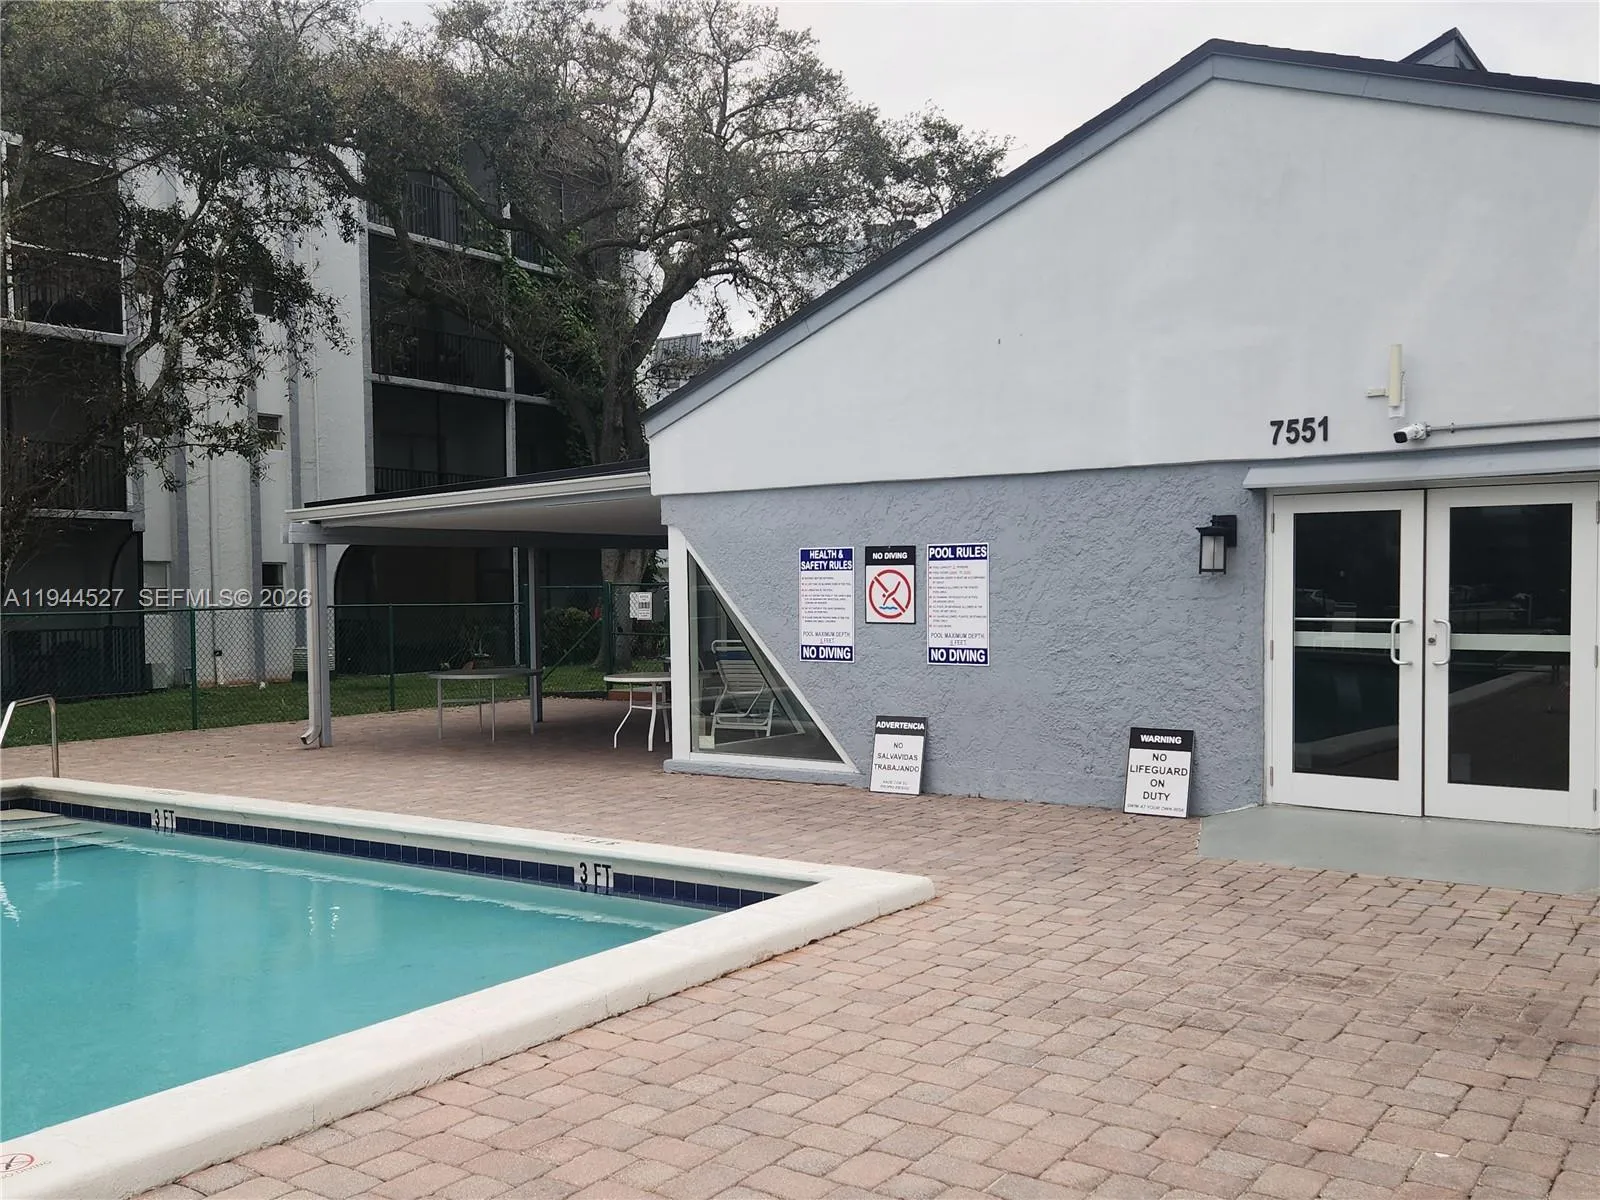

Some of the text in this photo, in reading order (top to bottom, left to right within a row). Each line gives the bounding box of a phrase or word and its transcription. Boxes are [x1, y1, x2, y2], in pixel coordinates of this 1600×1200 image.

[1270, 415, 1328, 446] 7551
[809, 550, 844, 559] HEALTH &
[872, 552, 908, 560] NO DIVING
[929, 546, 987, 558] POOL RULES
[801, 560, 852, 570] SAFETY RULES
[803, 646, 851, 660] NO DIVING
[931, 648, 986, 662] NO DIVING
[876, 721, 925, 730] ADVERTENCIA
[1140, 734, 1182, 744] WARNING
[877, 753, 918, 761] SALVAVIDAS
[1152, 753, 1167, 761] NO
[874, 763, 919, 773] TRABAJANDO
[1130, 765, 1188, 776] LIFEGUARD
[1150, 779, 1165, 787] ON
[1143, 791, 1171, 801] DUTY
[155, 808, 175, 829] 3 FT
[580, 862, 612, 887] 3 FT
